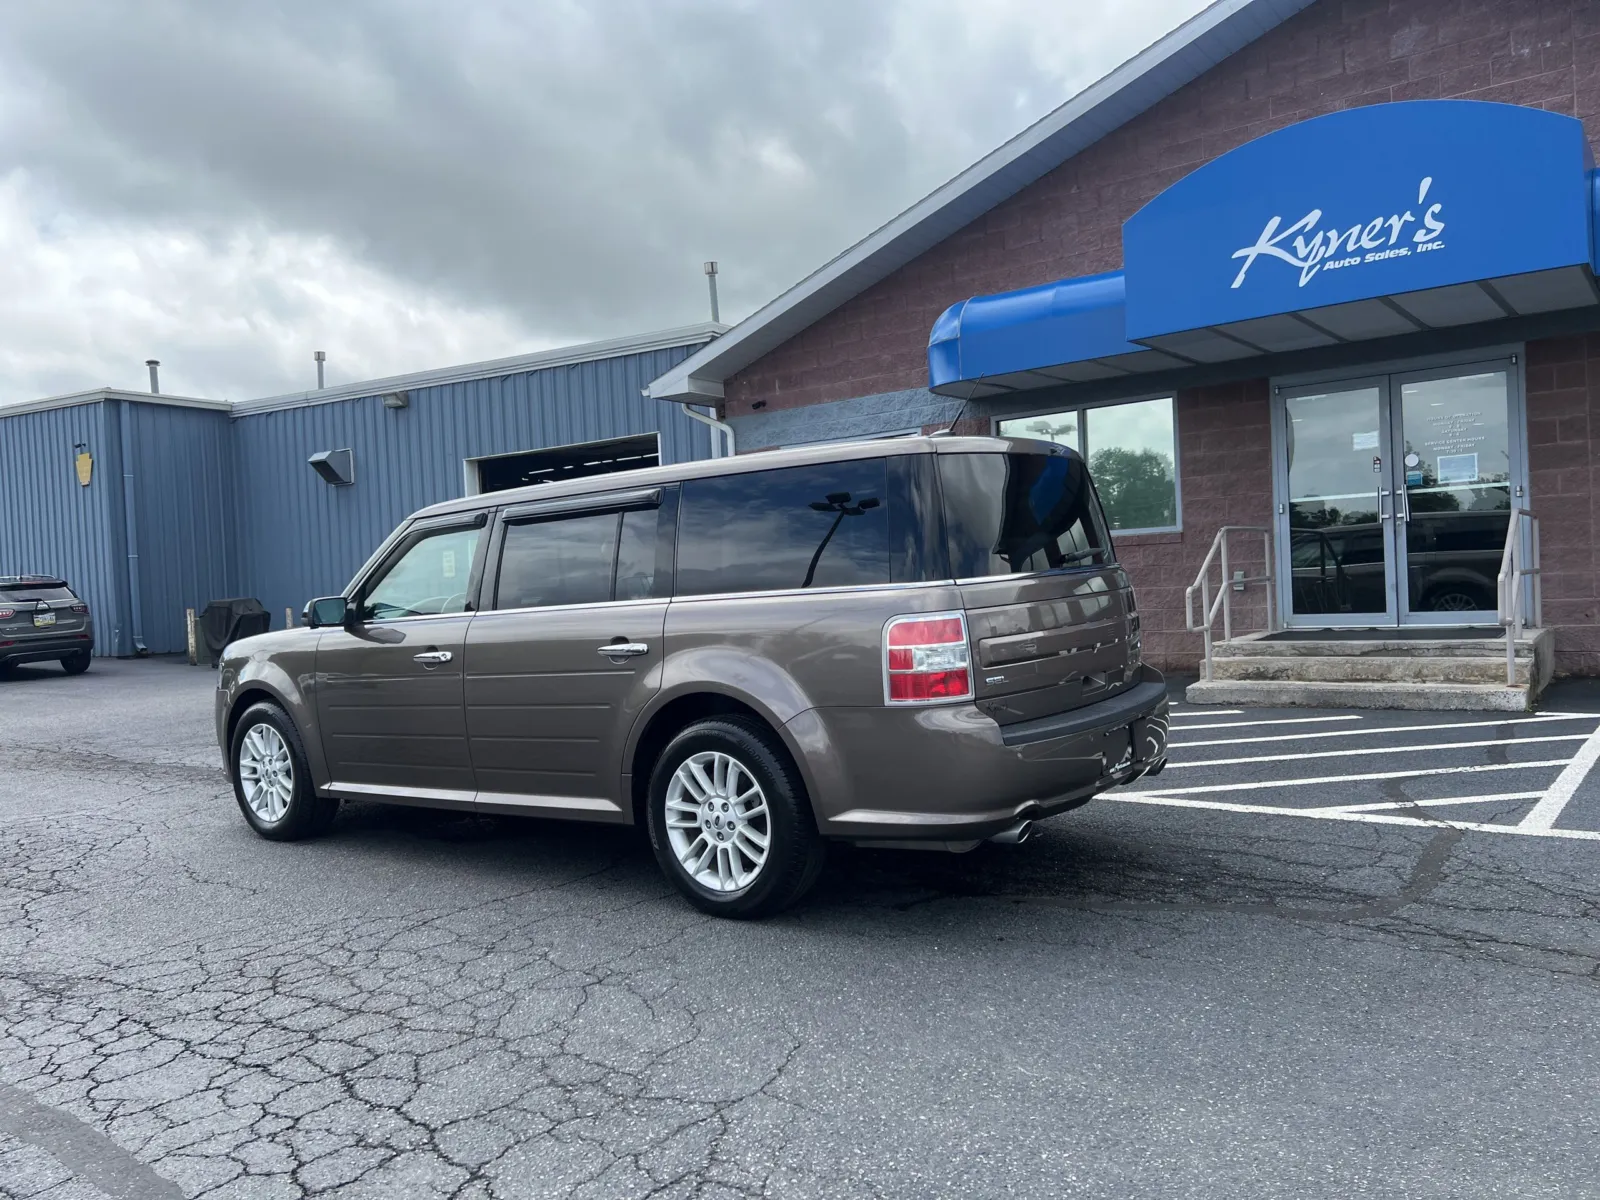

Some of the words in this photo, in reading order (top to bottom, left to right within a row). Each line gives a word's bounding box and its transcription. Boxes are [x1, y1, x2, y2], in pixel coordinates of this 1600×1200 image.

[1231, 176, 1446, 289] Kyner's
[1322, 256, 1361, 271] Auto
[1364, 247, 1412, 263] Sales,
[1416, 240, 1446, 253] Inc.
[985, 675, 1009, 685] SEL
